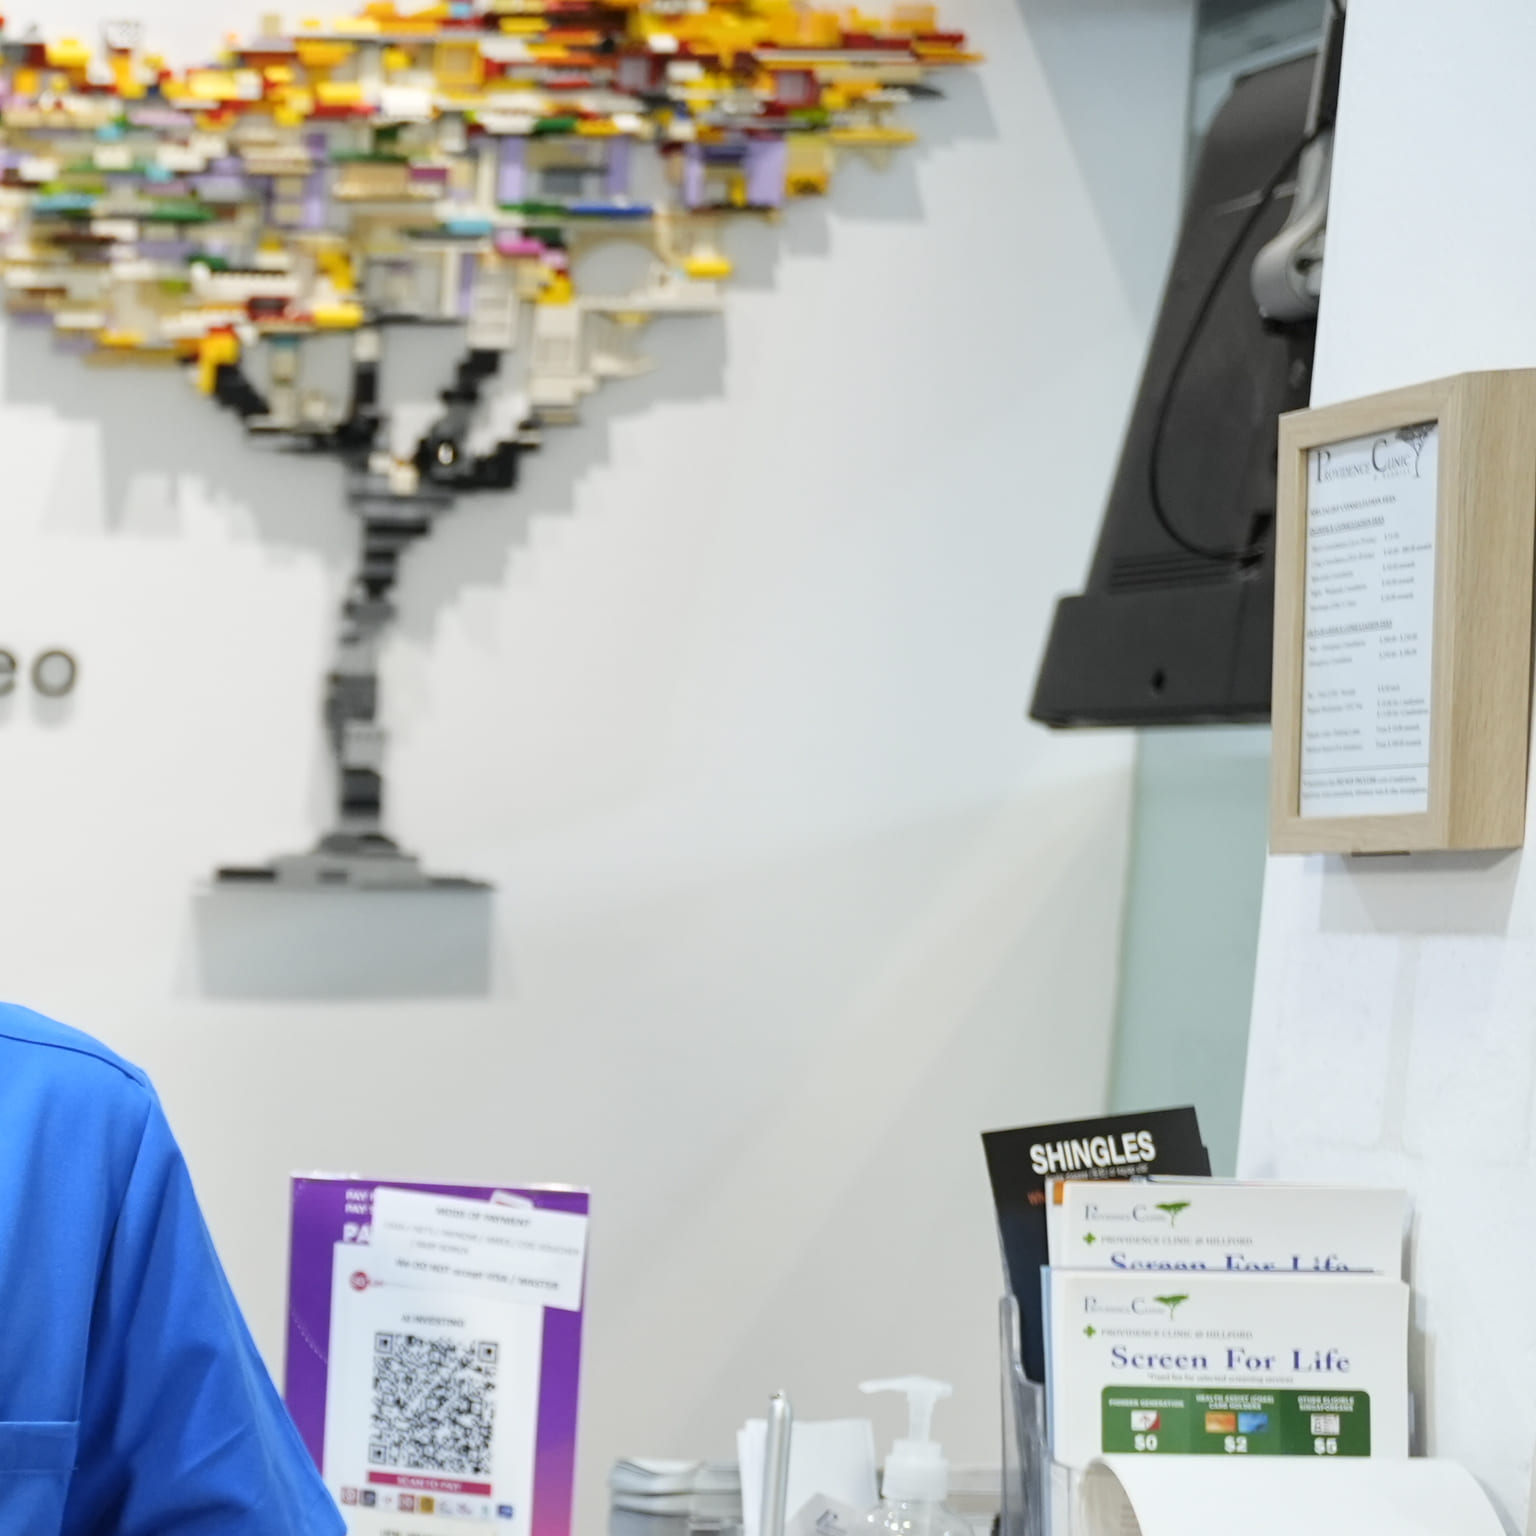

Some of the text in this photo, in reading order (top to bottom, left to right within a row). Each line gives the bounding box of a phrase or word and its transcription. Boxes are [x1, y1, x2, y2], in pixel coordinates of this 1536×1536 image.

[1030, 1130, 1156, 1175] SHINGLES
[1111, 1345, 1351, 1373] Screen For Life
[1134, 1434, 1158, 1452] $0
[1224, 1435, 1248, 1453] $2
